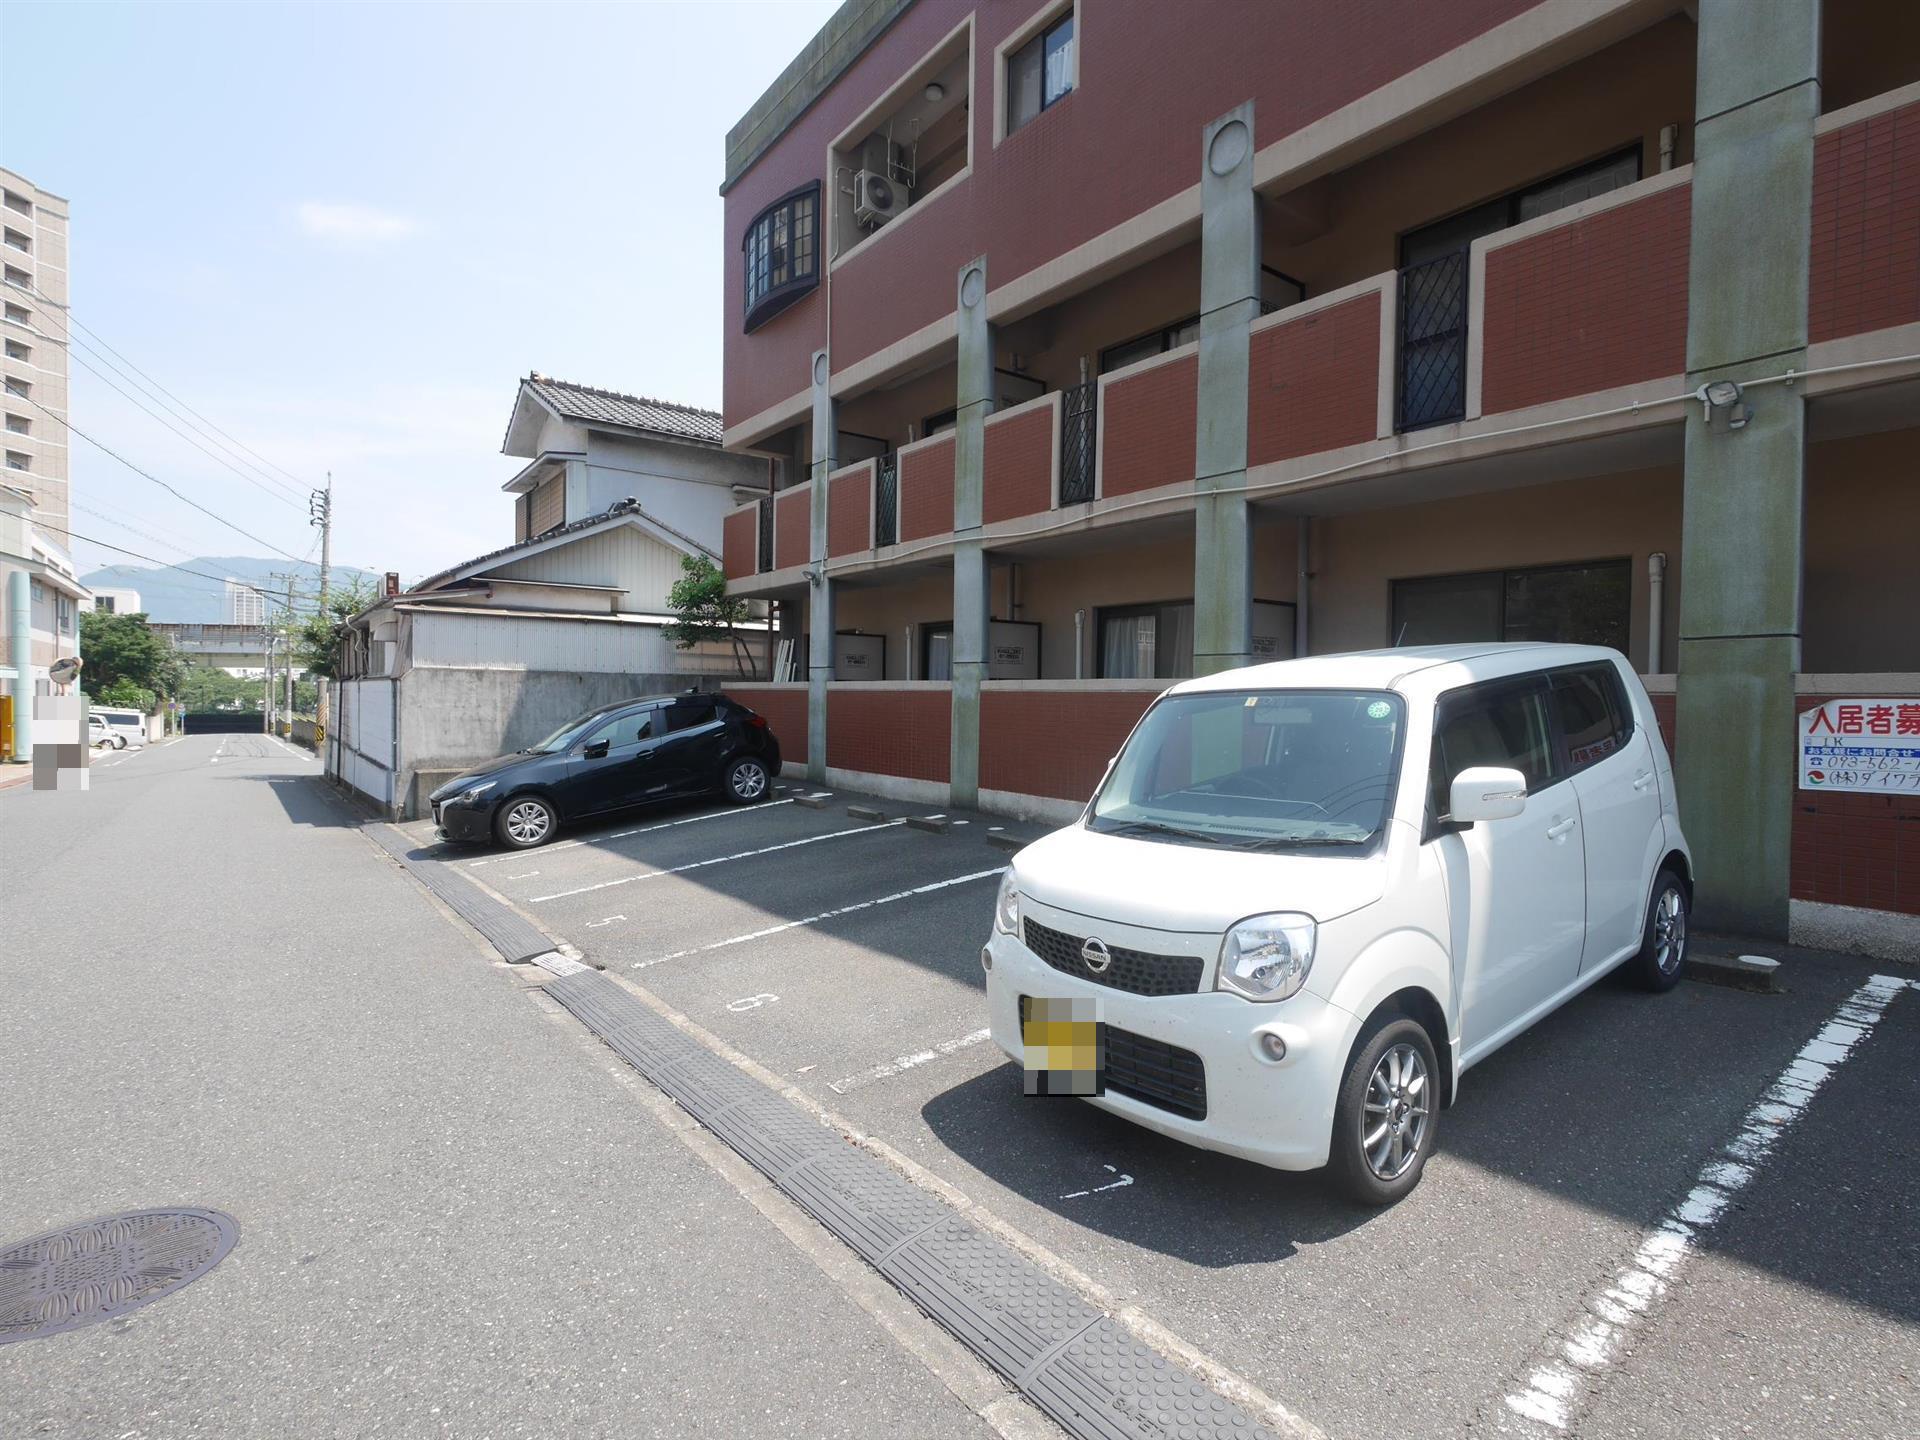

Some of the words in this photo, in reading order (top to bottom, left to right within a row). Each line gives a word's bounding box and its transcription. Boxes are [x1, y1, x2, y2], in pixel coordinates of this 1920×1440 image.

[1808, 704, 1920, 735] 入居者募
[1084, 949, 1106, 961] NISSAN
